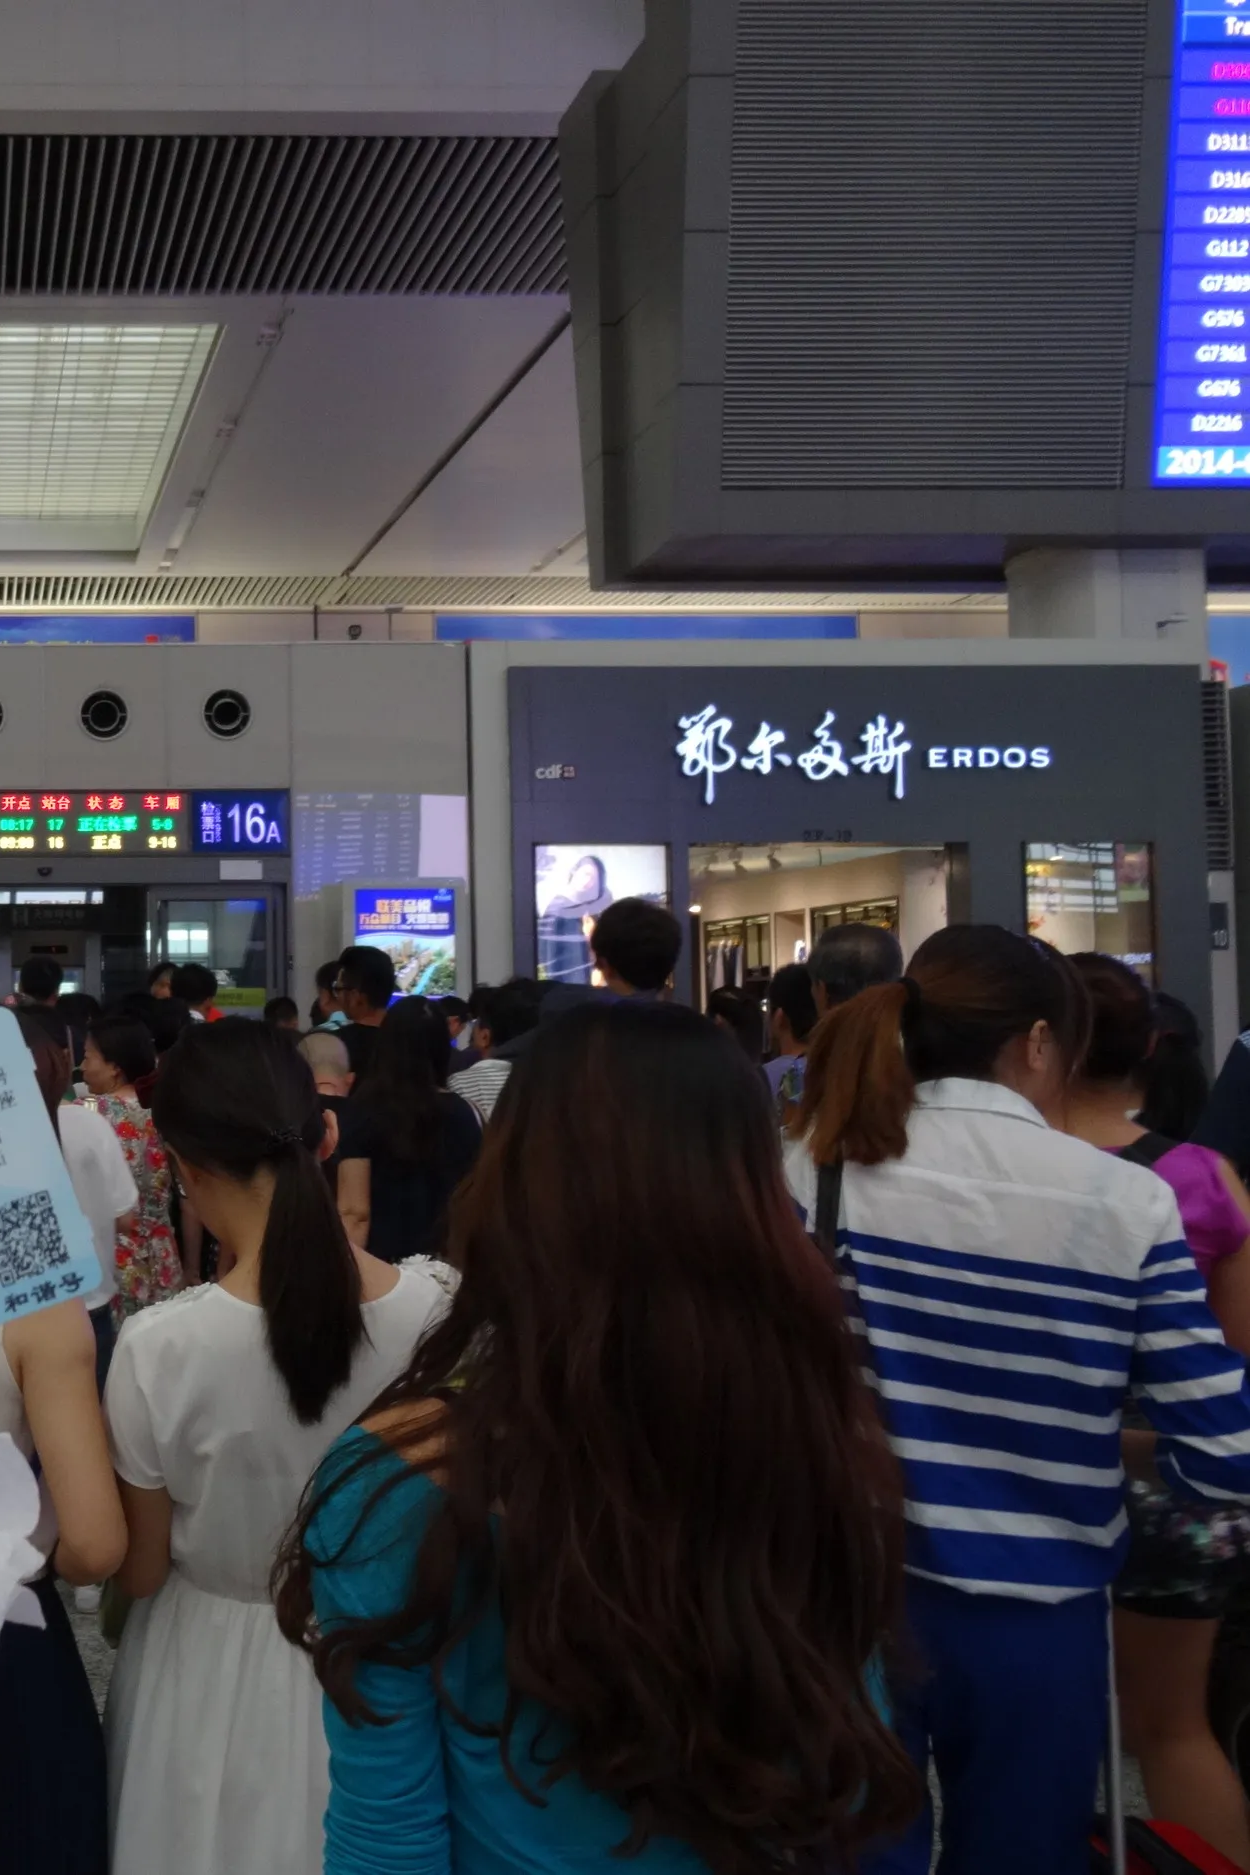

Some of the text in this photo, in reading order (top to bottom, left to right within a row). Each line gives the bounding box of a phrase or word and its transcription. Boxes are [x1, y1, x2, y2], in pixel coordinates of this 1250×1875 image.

[1207, 132, 1250, 152] D311
[928, 747, 1051, 768] ERDOS
[1, 796, 31, 810] 开点
[41, 796, 71, 810] 站台
[47, 818, 65, 831] 17
[228, 803, 282, 843] 16A
[47, 836, 65, 849] 16
[4, 1271, 85, 1313] 和谐号
